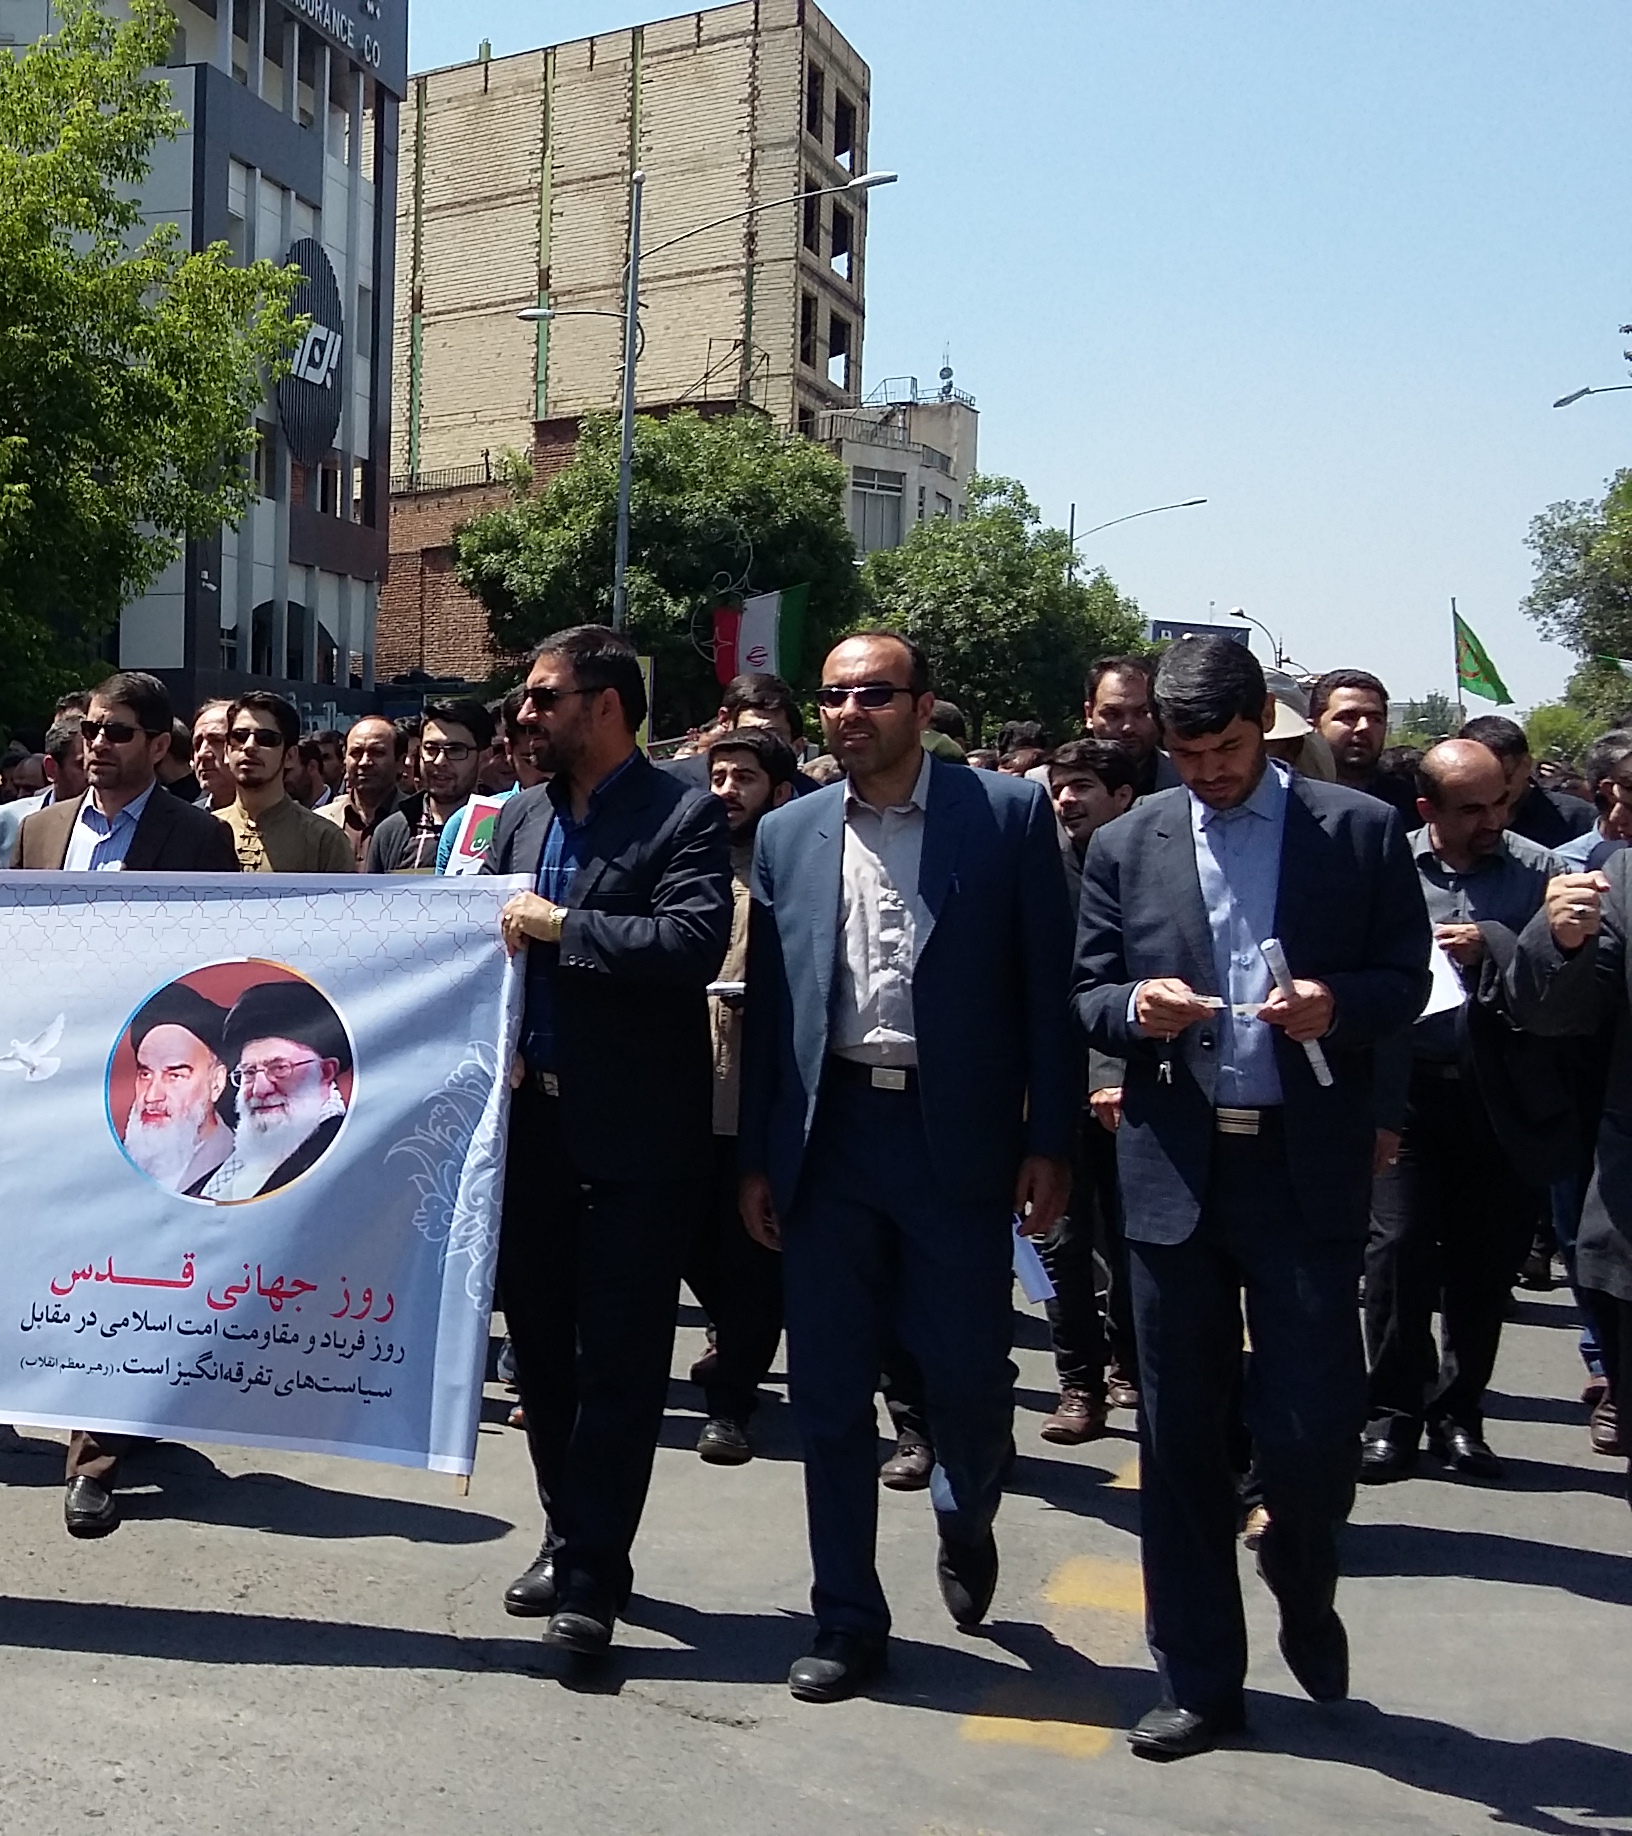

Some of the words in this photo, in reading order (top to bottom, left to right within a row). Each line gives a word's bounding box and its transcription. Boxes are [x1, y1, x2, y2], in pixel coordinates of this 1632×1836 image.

[364, 34, 381, 68] CO
[50, 1252, 197, 1297] قدس
[206, 1262, 318, 1313] جهانی
[329, 1276, 396, 1323] روز
[20, 1301, 71, 1333] مقابل
[74, 1312, 99, 1335] در
[99, 1310, 173, 1339] اسلامی
[176, 1317, 219, 1337] امت
[222, 1321, 300, 1350] مقاومت
[306, 1337, 317, 1357] و
[319, 1329, 366, 1360] فریاد
[369, 1334, 406, 1365] روز
